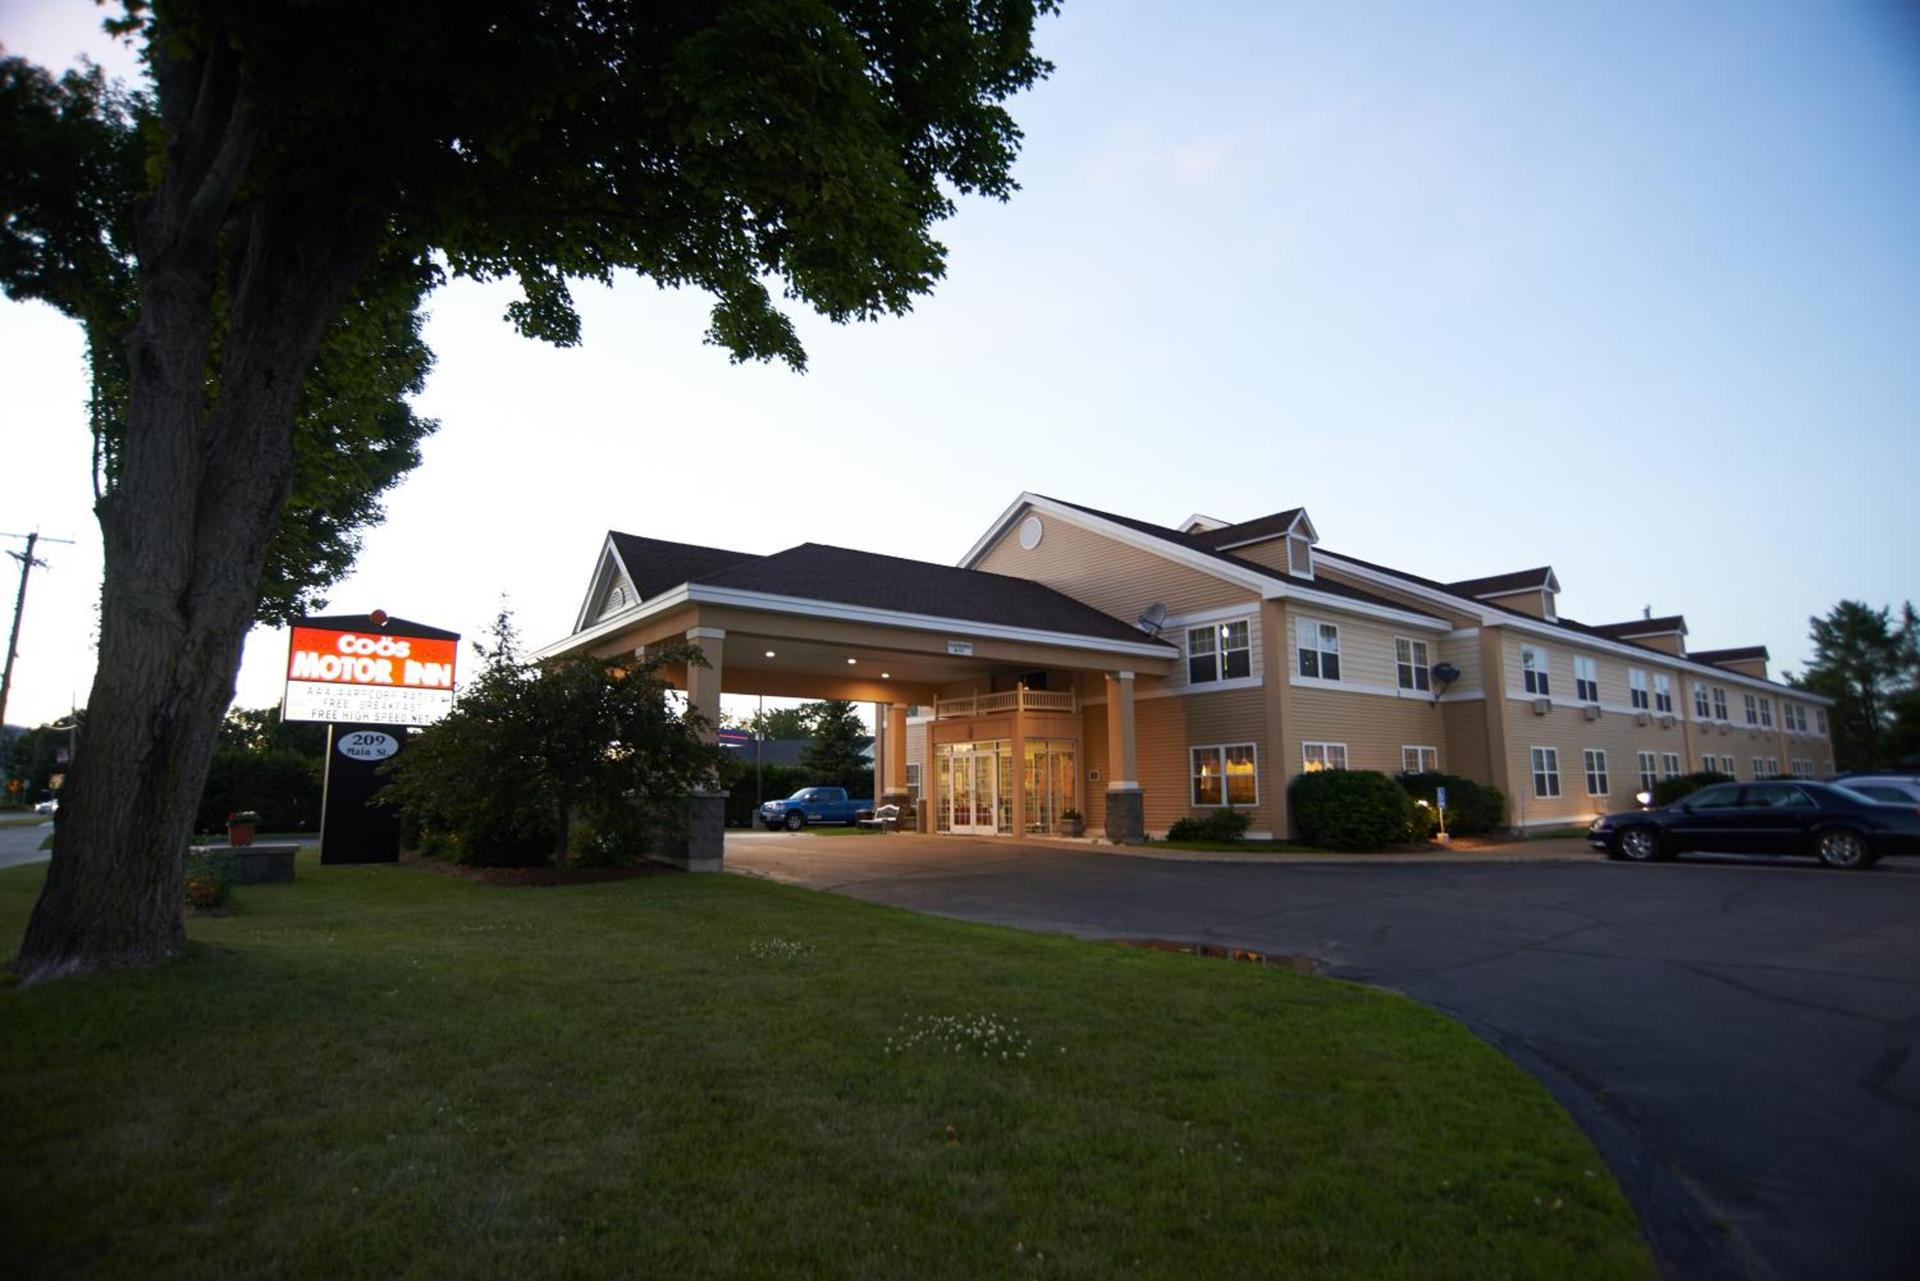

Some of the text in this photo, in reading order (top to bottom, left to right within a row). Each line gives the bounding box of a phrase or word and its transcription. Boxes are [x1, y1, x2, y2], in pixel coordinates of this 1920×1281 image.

[291, 651, 452, 686] MOTOR INN
[323, 698, 348, 709] FREE
[311, 708, 429, 724] FREE HIGH SPEED NET
[352, 734, 386, 746] 209
